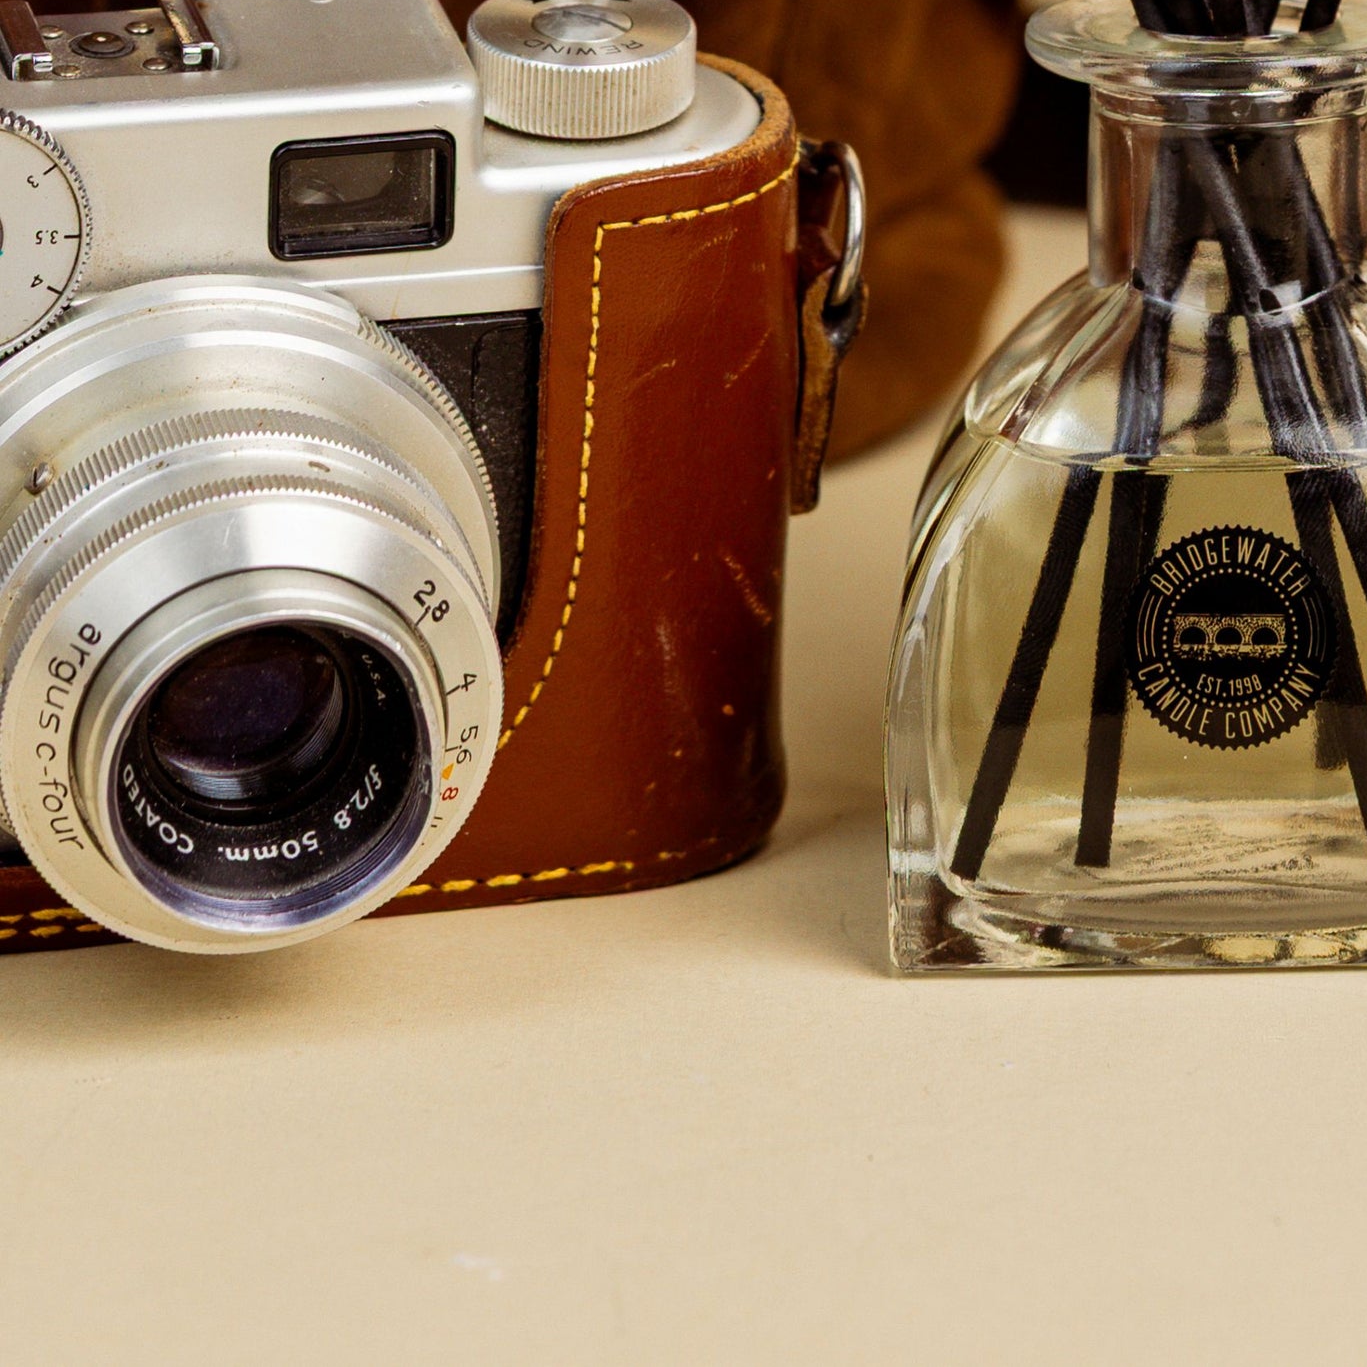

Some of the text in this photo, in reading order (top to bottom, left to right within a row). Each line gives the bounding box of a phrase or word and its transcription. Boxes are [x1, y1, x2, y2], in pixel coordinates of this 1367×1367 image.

[523, 39, 645, 56] REWIND
[27, 175, 40, 190] 3
[35, 229, 59, 245] 3.5
[30, 273, 44, 288] 4
[1150, 536, 1312, 597] BRIDGEWATER
[460, 672, 477, 692] 4
[1138, 663, 1320, 739] CANDLE COMPANY
[35, 622, 102, 851] argus c-four
[442, 787, 459, 801] 8
[122, 763, 383, 862] f/2.8 50mm. COATED
